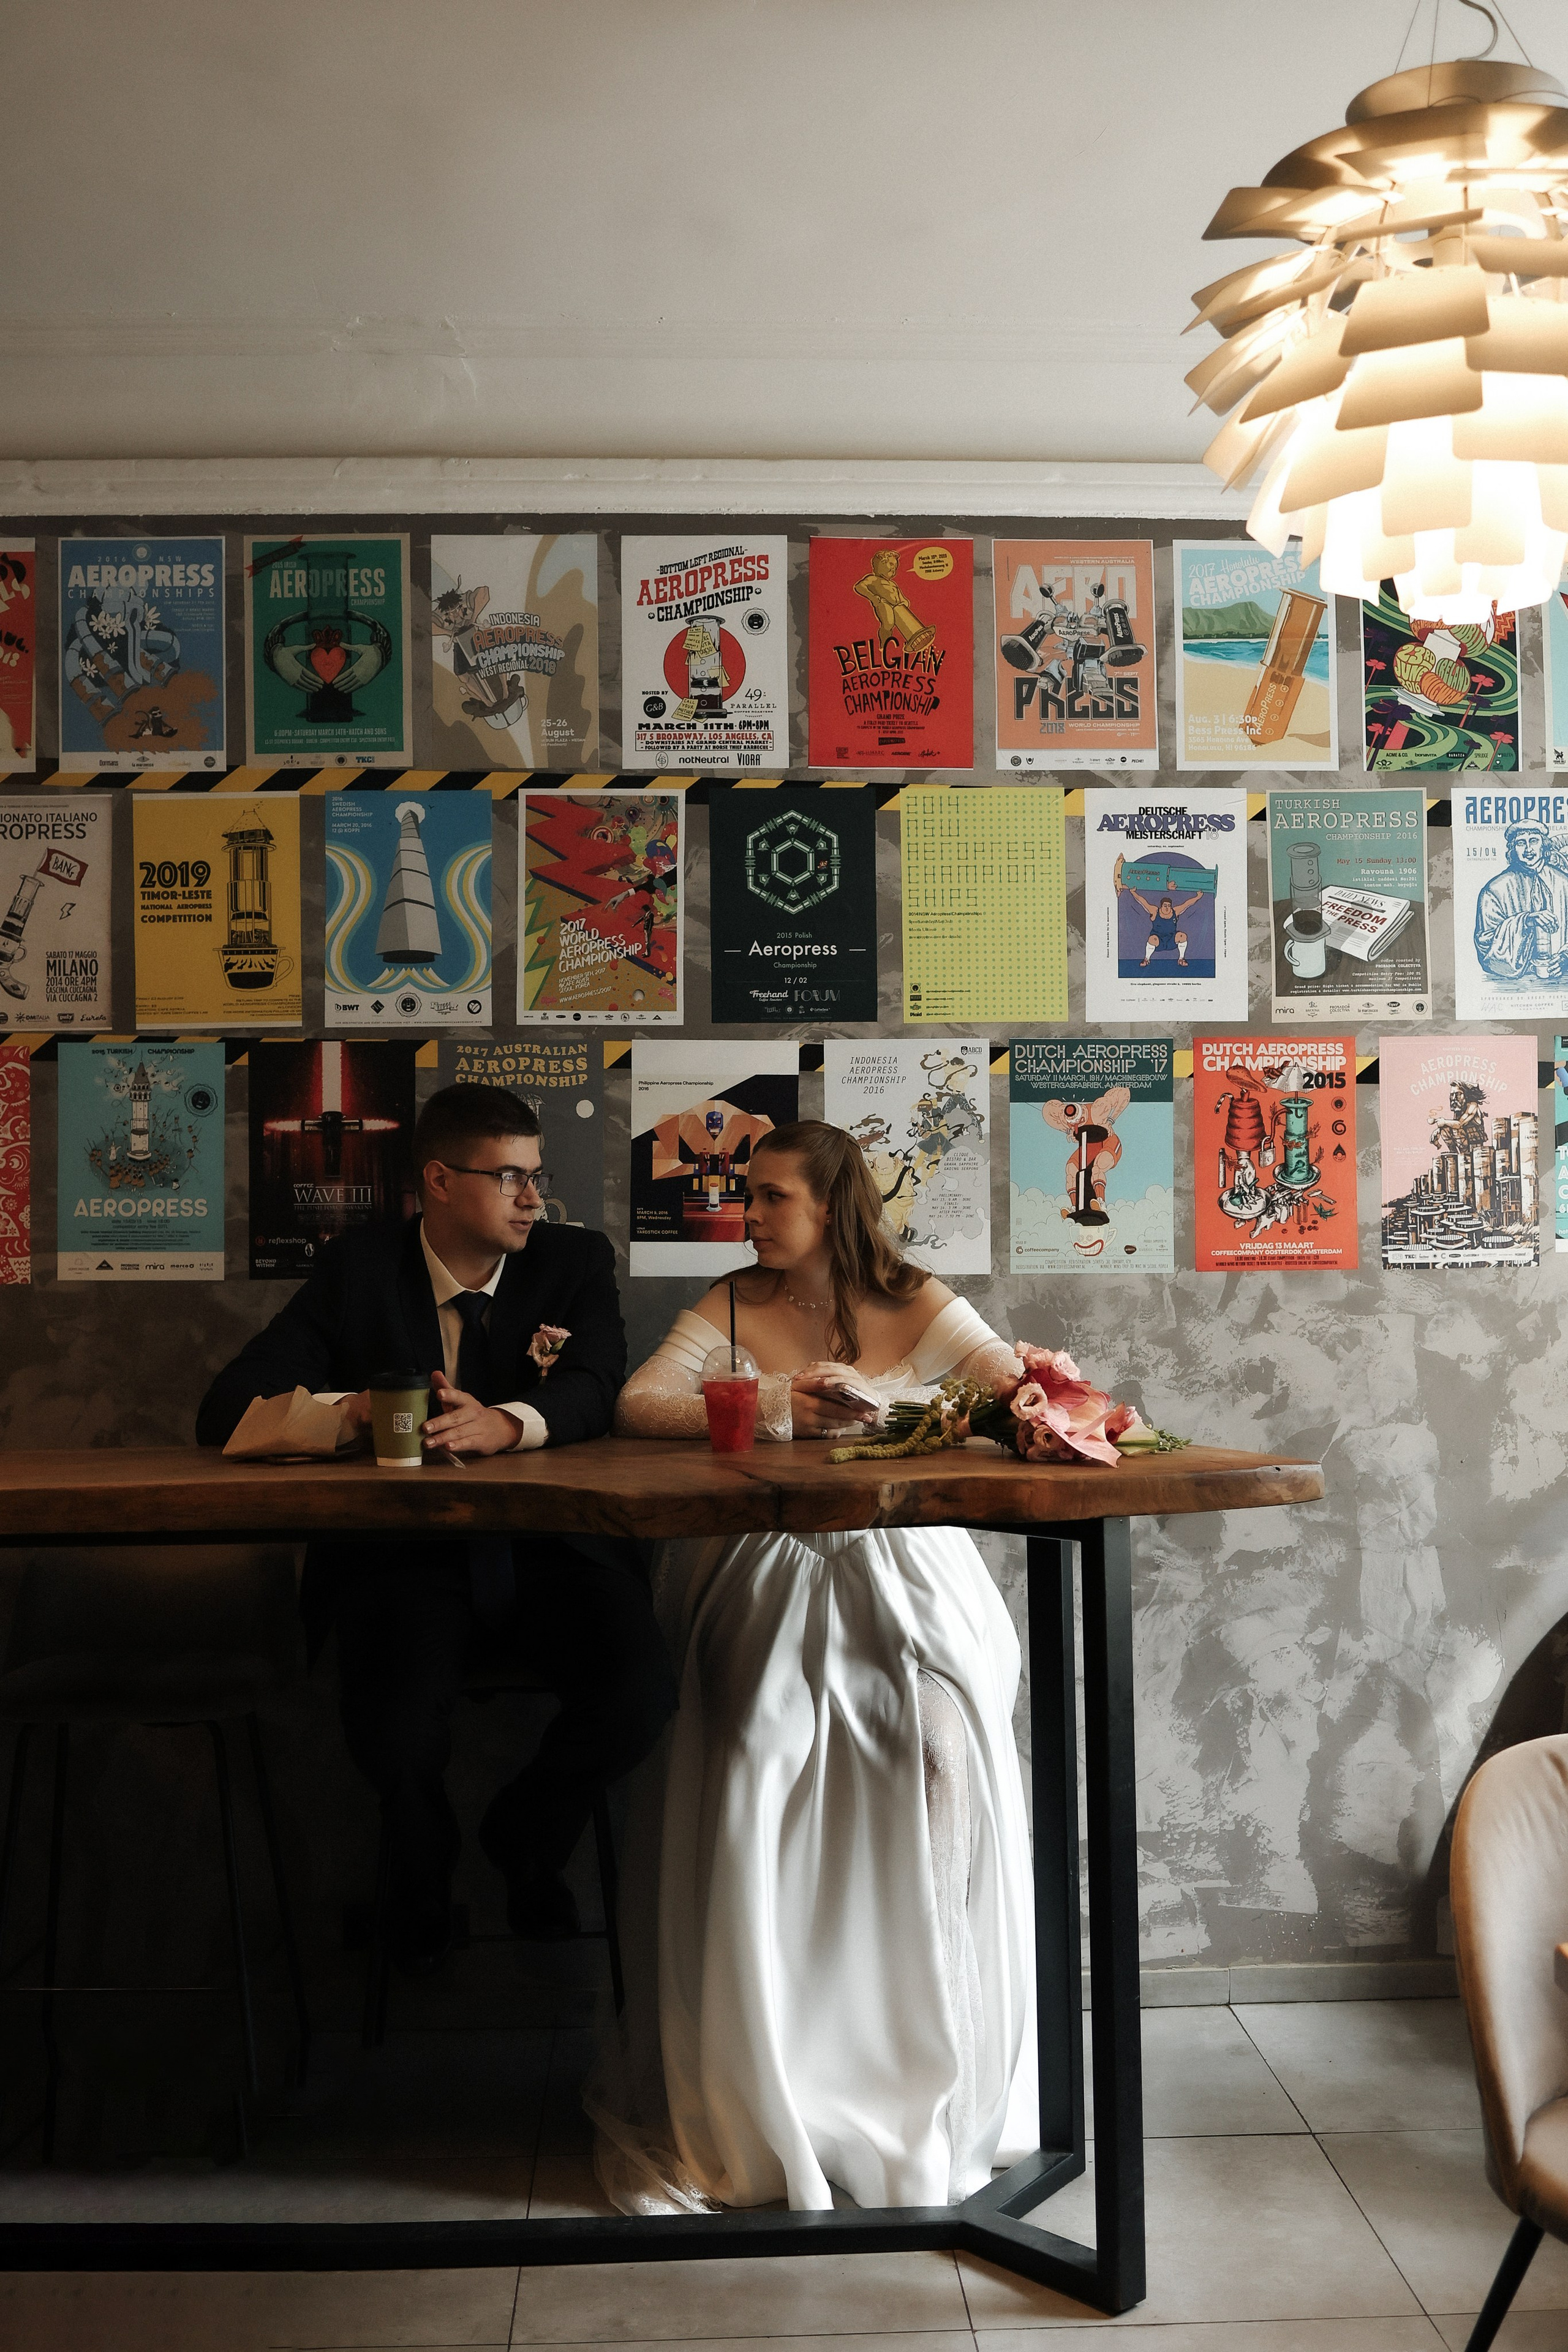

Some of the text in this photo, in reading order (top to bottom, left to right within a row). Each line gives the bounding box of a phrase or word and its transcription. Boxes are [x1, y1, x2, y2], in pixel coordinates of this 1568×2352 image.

[689, 555, 707, 568] LEFT
[1189, 557, 1259, 578] 2017 Honolulu
[68, 564, 214, 587] AEROPRESS
[270, 568, 386, 598] AEROPRESS
[636, 554, 769, 606] AEROPRESS
[1011, 564, 1137, 618] AERO
[1189, 569, 1306, 606] CHAMPIONSHIP
[657, 586, 754, 622] CHAMPIONSHIP
[490, 613, 540, 627] INDONESIA
[473, 626, 564, 650] AEROPRESS
[478, 644, 565, 668] CHAMPIONSHIP
[832, 636, 946, 676] BELGIAN
[478, 657, 556, 679] WEST REGIONAL 2018
[842, 671, 936, 695] AEROPRESS
[844, 690, 940, 716] CHAMPIONSHIP
[1014, 677, 1140, 720] PRESS
[646, 703, 663, 712] G&B
[540, 728, 575, 737] August
[739, 720, 769, 730] 6PM-8PM
[1040, 722, 1065, 734] 2018
[679, 756, 729, 764] notNeutral
[737, 753, 761, 766] VIORA
[908, 796, 959, 814] 2014
[1139, 807, 1188, 815] DEUTSCHE
[1276, 800, 1340, 810] TURKISH
[46, 813, 97, 822] ITALIANO
[1097, 814, 1235, 832] AEROPRESS
[1274, 811, 1419, 829] AEROPRESS
[1126, 827, 1218, 840] MEISTERSCHAFT 18
[53, 856, 76, 878] BANG
[139, 861, 211, 888] 2019
[141, 890, 212, 900] TIMOR-LESTE
[909, 889, 978, 907] SHIPS
[141, 914, 212, 923] COMPETITION
[1322, 902, 1387, 925] FREEDOM
[560, 919, 586, 935] 2017
[1338, 916, 1378, 933] PRESS
[559, 927, 599, 947] WORLD
[560, 934, 626, 959] AEROPRESS
[748, 940, 838, 960] Aeropress
[559, 943, 642, 972] CHAMPIONSHIP
[47, 960, 98, 976] MILANO
[47, 976, 96, 986] 2014 ORE 4PM
[794, 990, 840, 1001] FORUM
[456, 1044, 587, 1057] 2017 AUSTRALIAN
[1015, 1044, 1168, 1058] DUTCH AEROPRESS
[1202, 1043, 1343, 1055] DUTCH AEROPRESS
[455, 1057, 587, 1074] AEROPRESS
[1015, 1060, 1136, 1072] CHAMPIONSHIP
[1203, 1056, 1346, 1071] CHAMPIONSHIP
[1420, 1055, 1497, 1076] AEROPRESS
[456, 1074, 588, 1088] CHAMPIONSHIP
[1303, 1072, 1346, 1088] 2015
[1410, 1070, 1508, 1096] CHAMPIONSHIP
[294, 1188, 371, 1203] WAVE III
[74, 1198, 208, 1218] AEROPRESS
